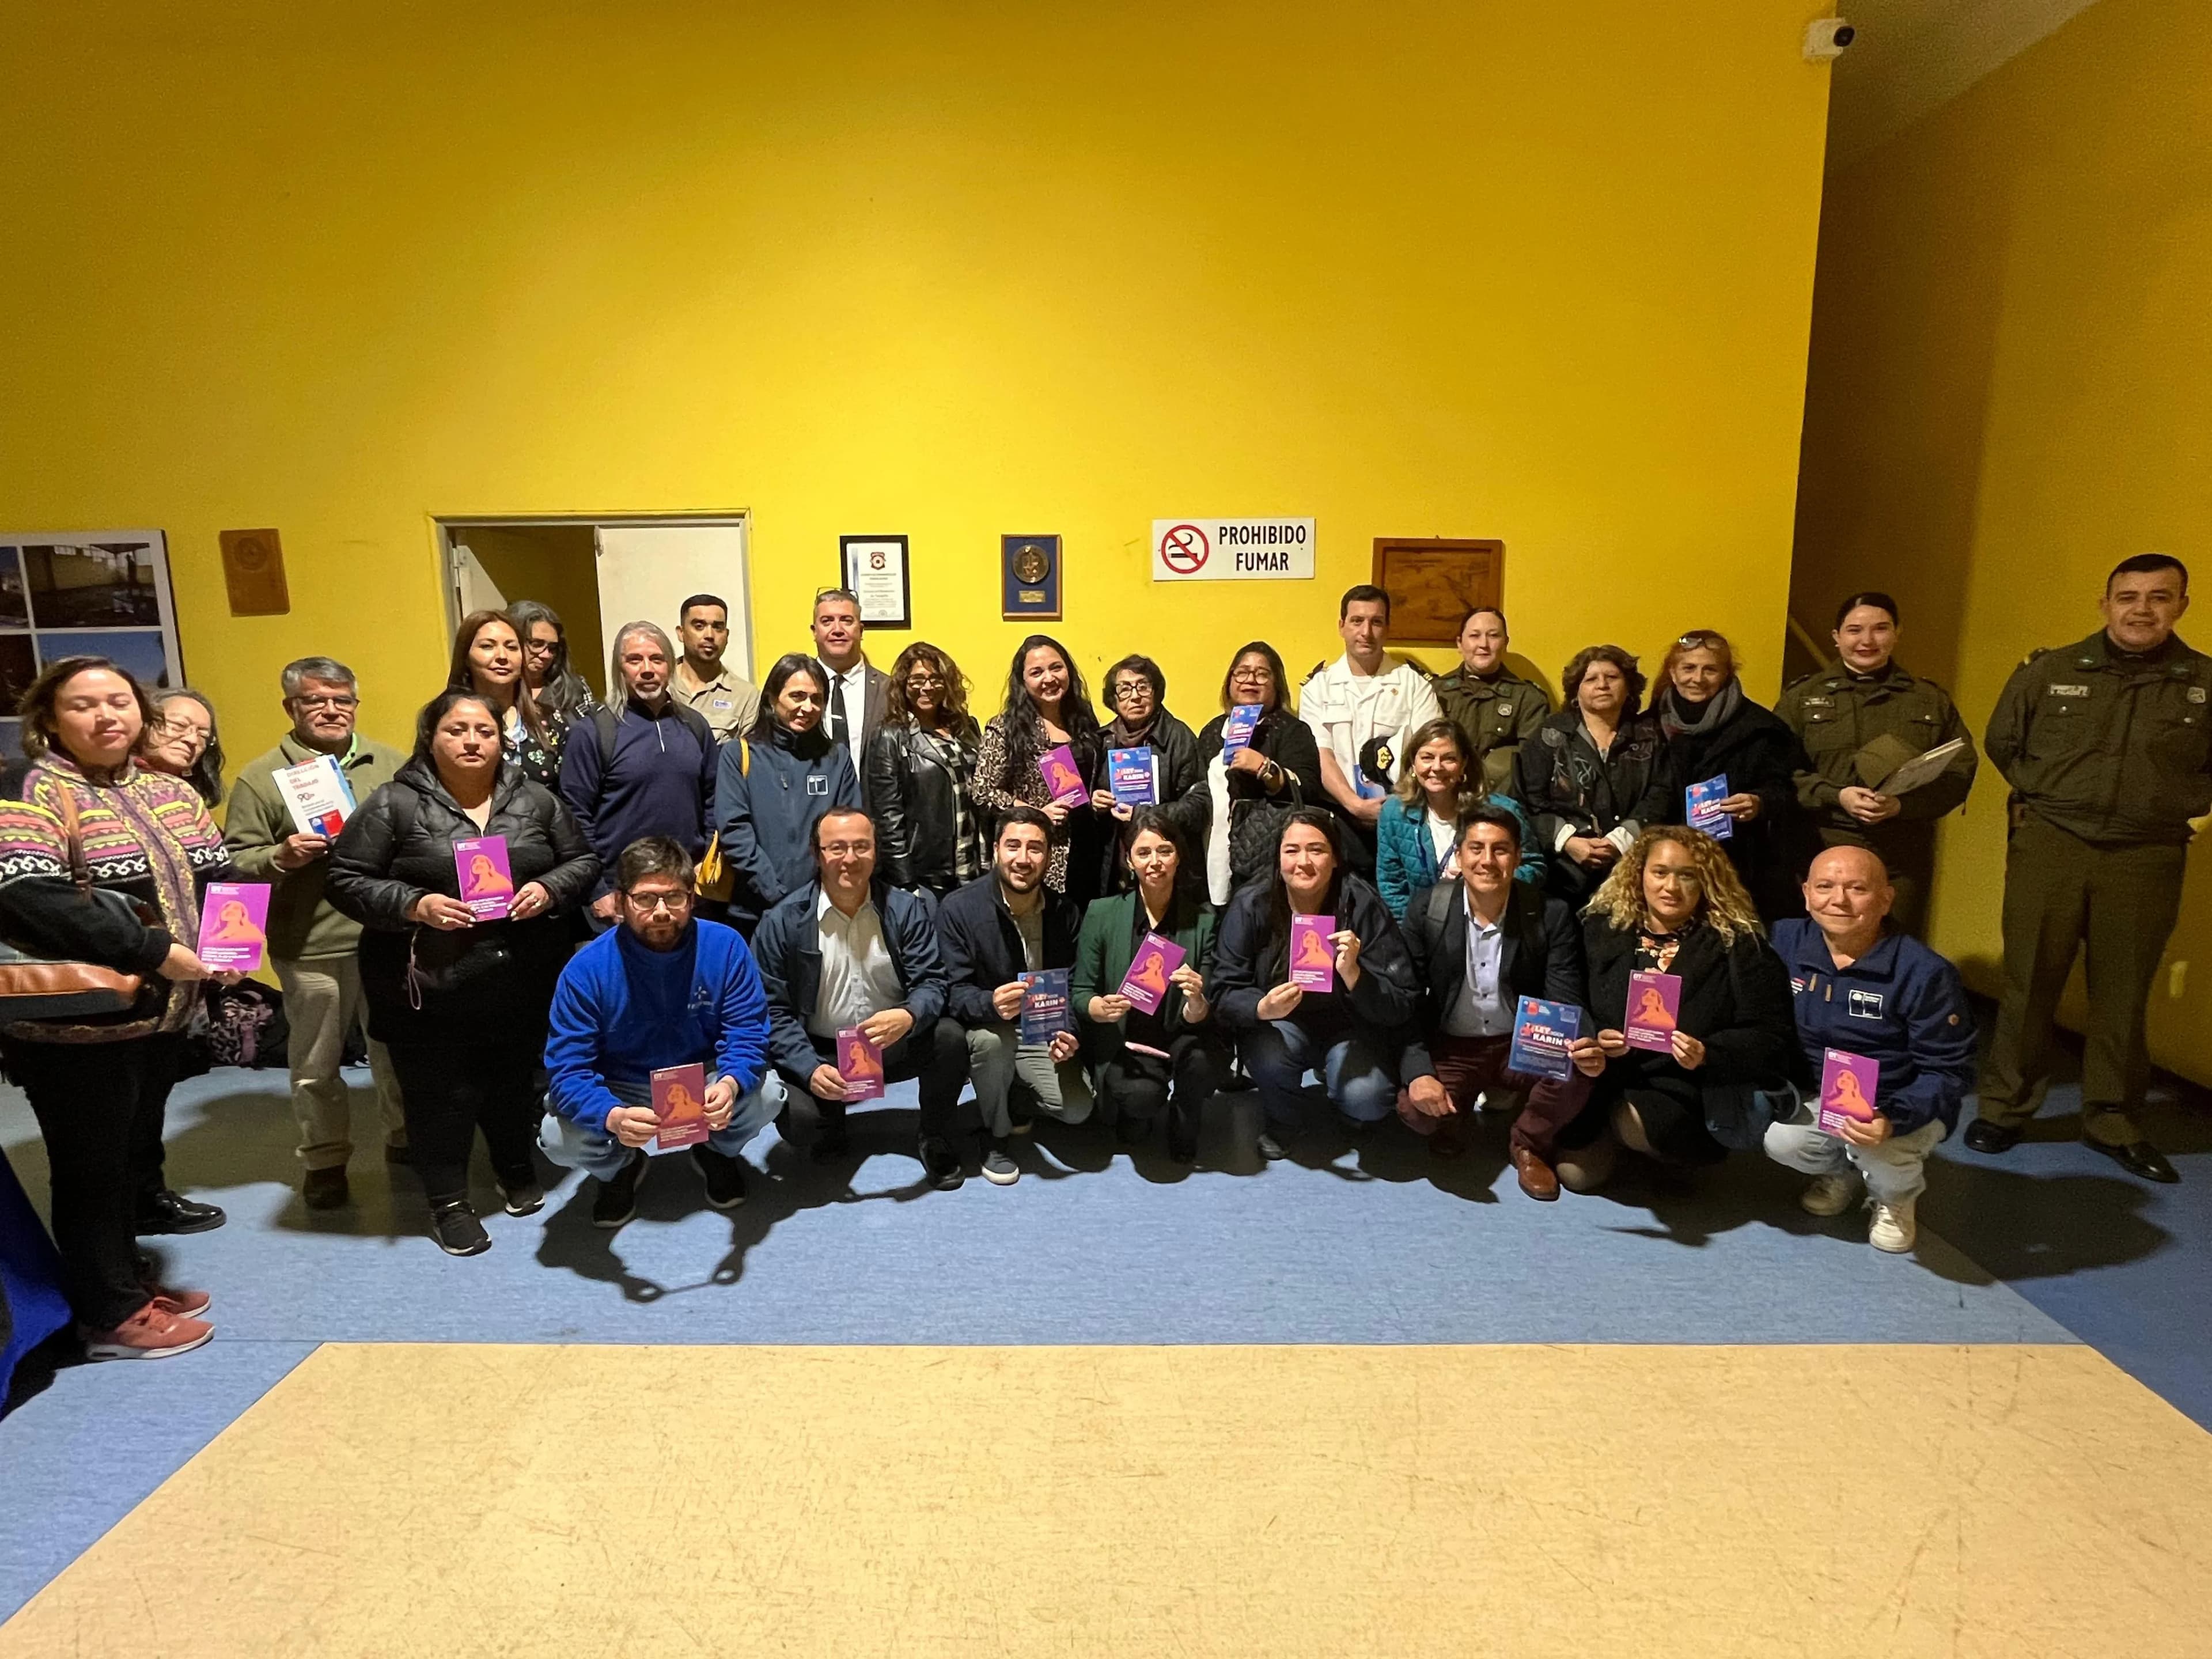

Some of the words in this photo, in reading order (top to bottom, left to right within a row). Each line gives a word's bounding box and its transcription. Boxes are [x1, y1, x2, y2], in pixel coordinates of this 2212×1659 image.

[1219, 525, 1306, 545] PROHIBIDO
[1236, 552, 1289, 571] FUMAR
[1034, 999, 1058, 1008] KARIN
[1534, 1025, 1551, 1035] LEY
[1533, 1033, 1563, 1046] KARIN
